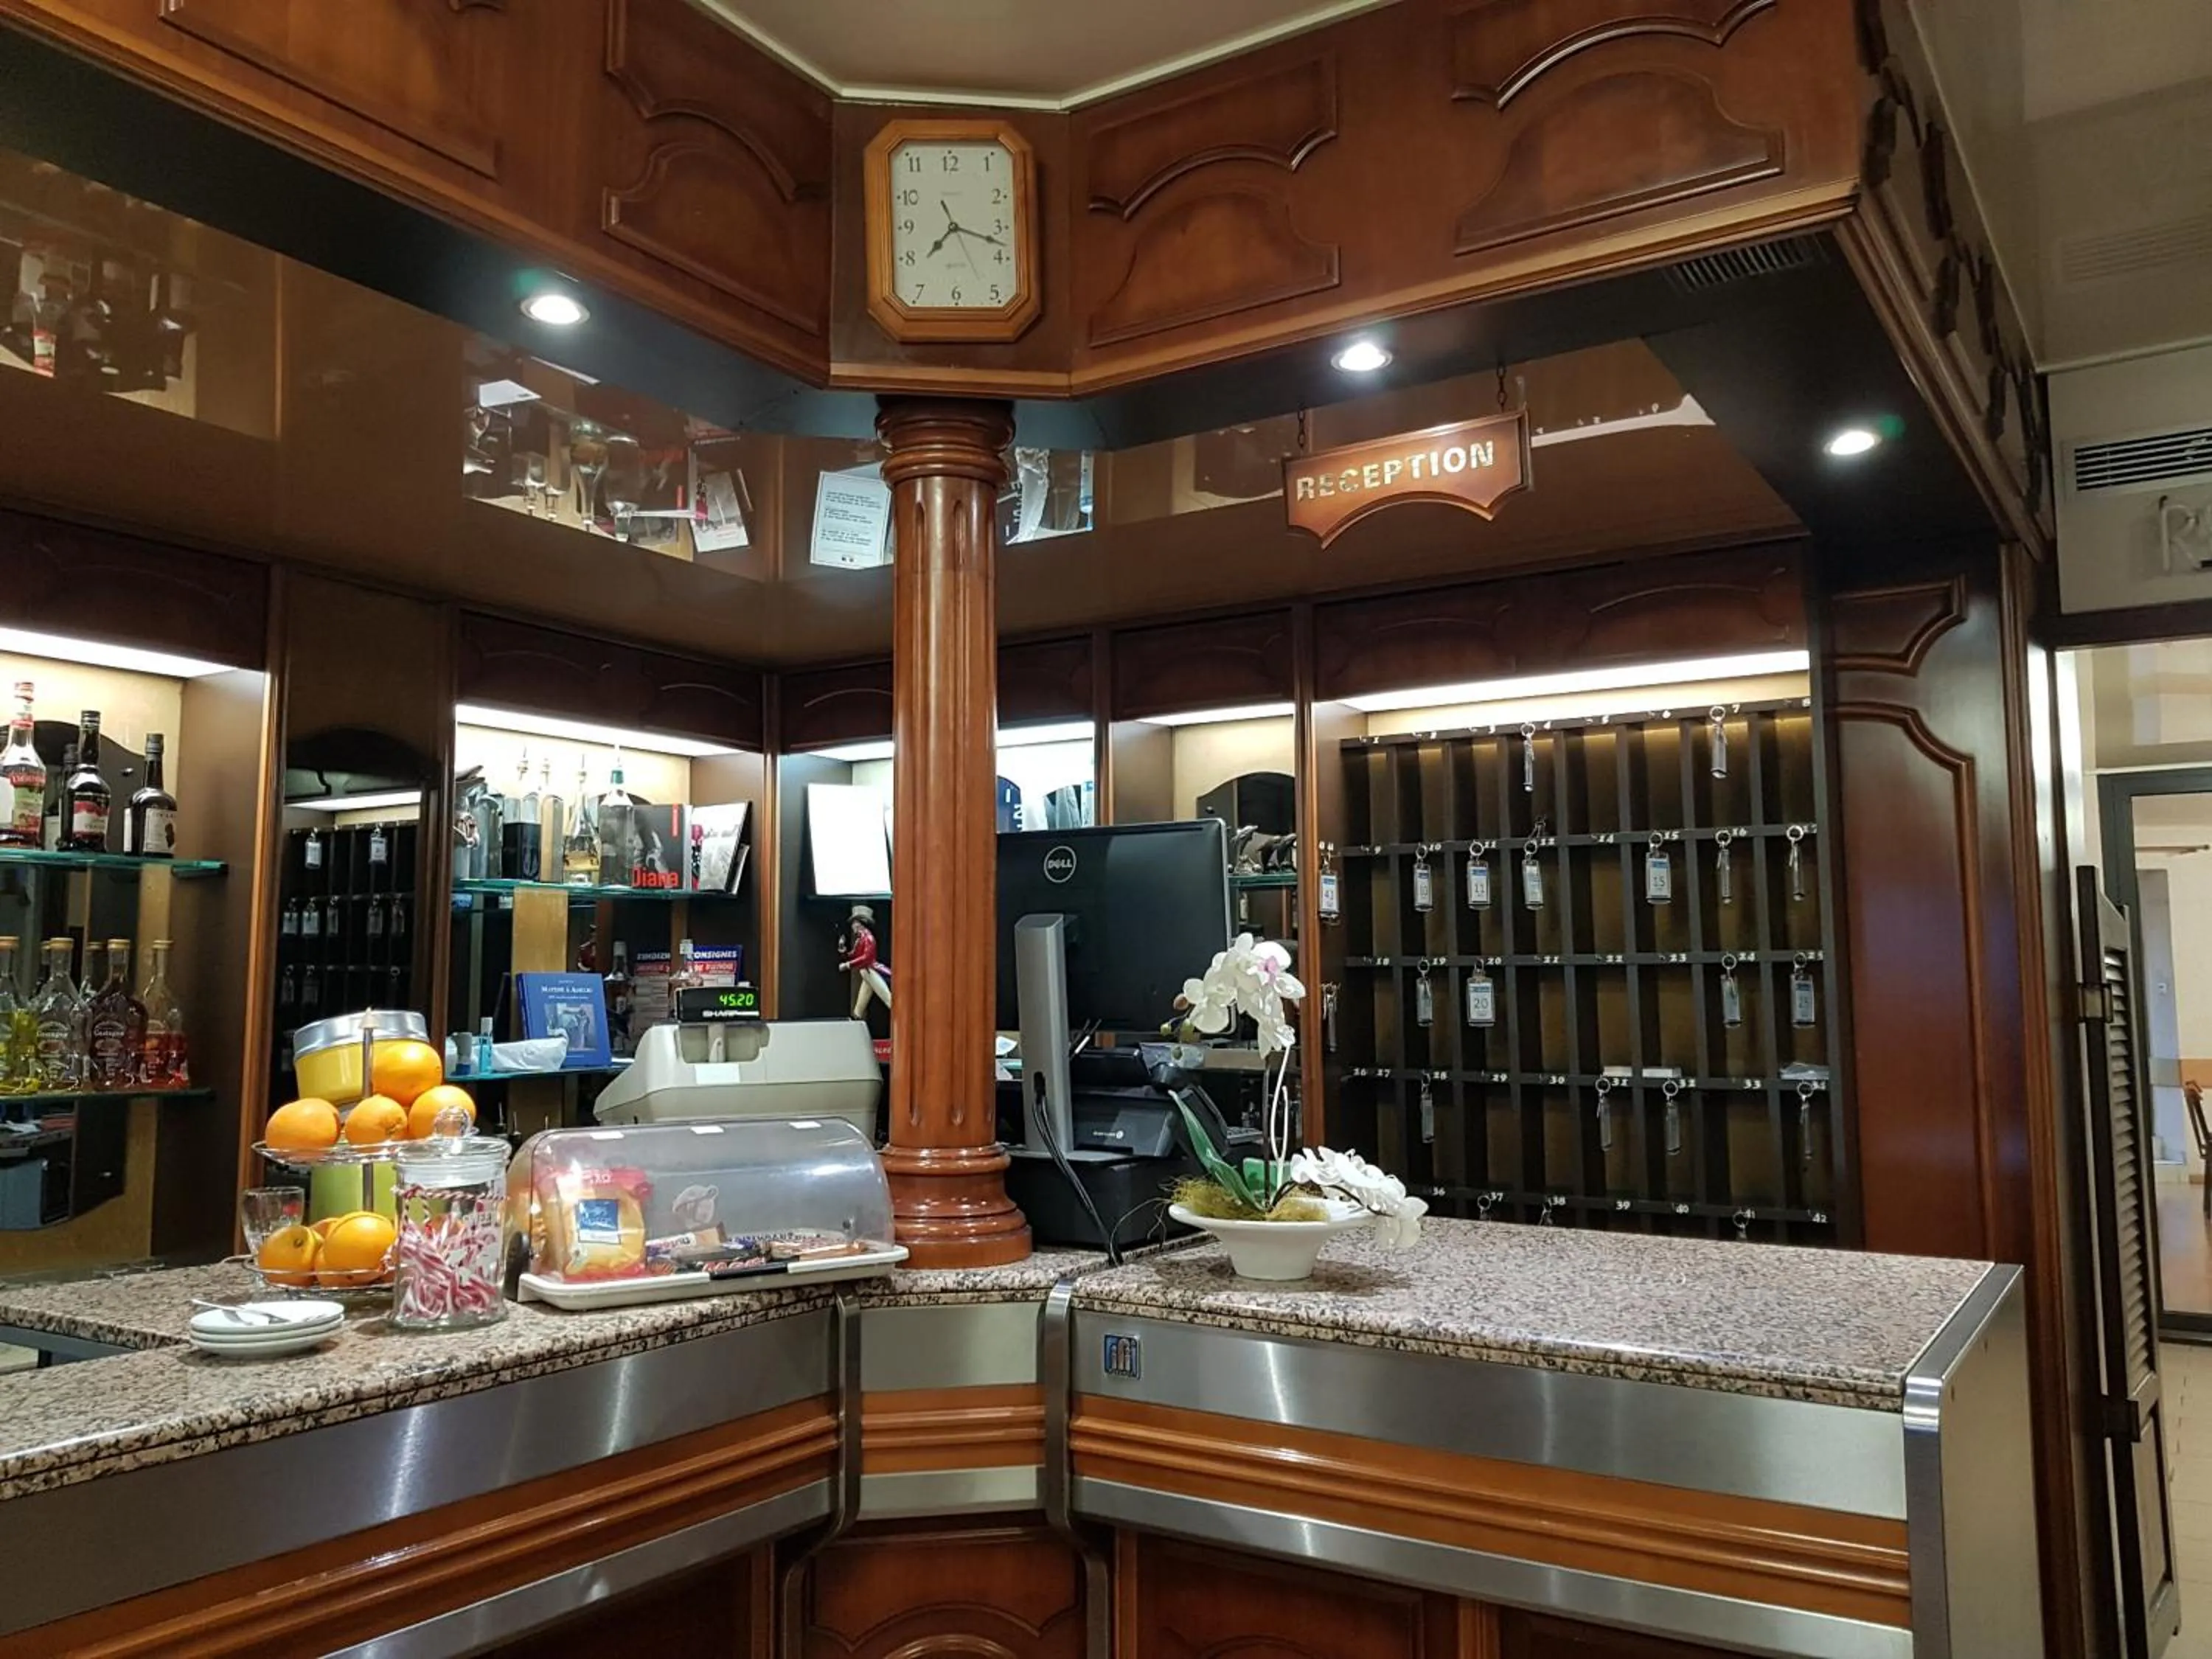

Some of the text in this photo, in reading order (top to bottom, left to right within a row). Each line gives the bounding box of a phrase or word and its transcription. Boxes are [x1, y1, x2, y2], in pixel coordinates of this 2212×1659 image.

[908, 156, 921, 172] 11
[942, 156, 959, 172] 12
[984, 156, 990, 172] 1
[902, 189, 918, 206] 10
[992, 188, 1001, 204] 2
[904, 220, 914, 234] 9
[993, 219, 1002, 235] 3
[905, 251, 915, 265] 8
[993, 249, 1003, 265] 4
[915, 284, 924, 299] 7
[951, 286, 961, 300] 6
[990, 285, 999, 300] 5
[1297, 441, 1494, 501] RECEPTION
[1732, 703, 1740, 713] 7
[1599, 834, 1613, 844] 14
[1663, 831, 1680, 840] 15
[1048, 859, 1073, 869] DELL
[632, 866, 679, 888] Diana
[1475, 998, 1488, 1009] 20
[1377, 1069, 1391, 1077] 27
[1492, 1074, 1507, 1082] 29
[1550, 1076, 1565, 1084] 30
[1743, 1079, 1761, 1088] 33
[1433, 1186, 1446, 1196] 36
[1490, 1192, 1503, 1201] 37
[1552, 1197, 1565, 1206] 38
[1616, 1200, 1631, 1210] 39
[1676, 1204, 1689, 1214] 40
[1812, 1213, 1827, 1223] 42
